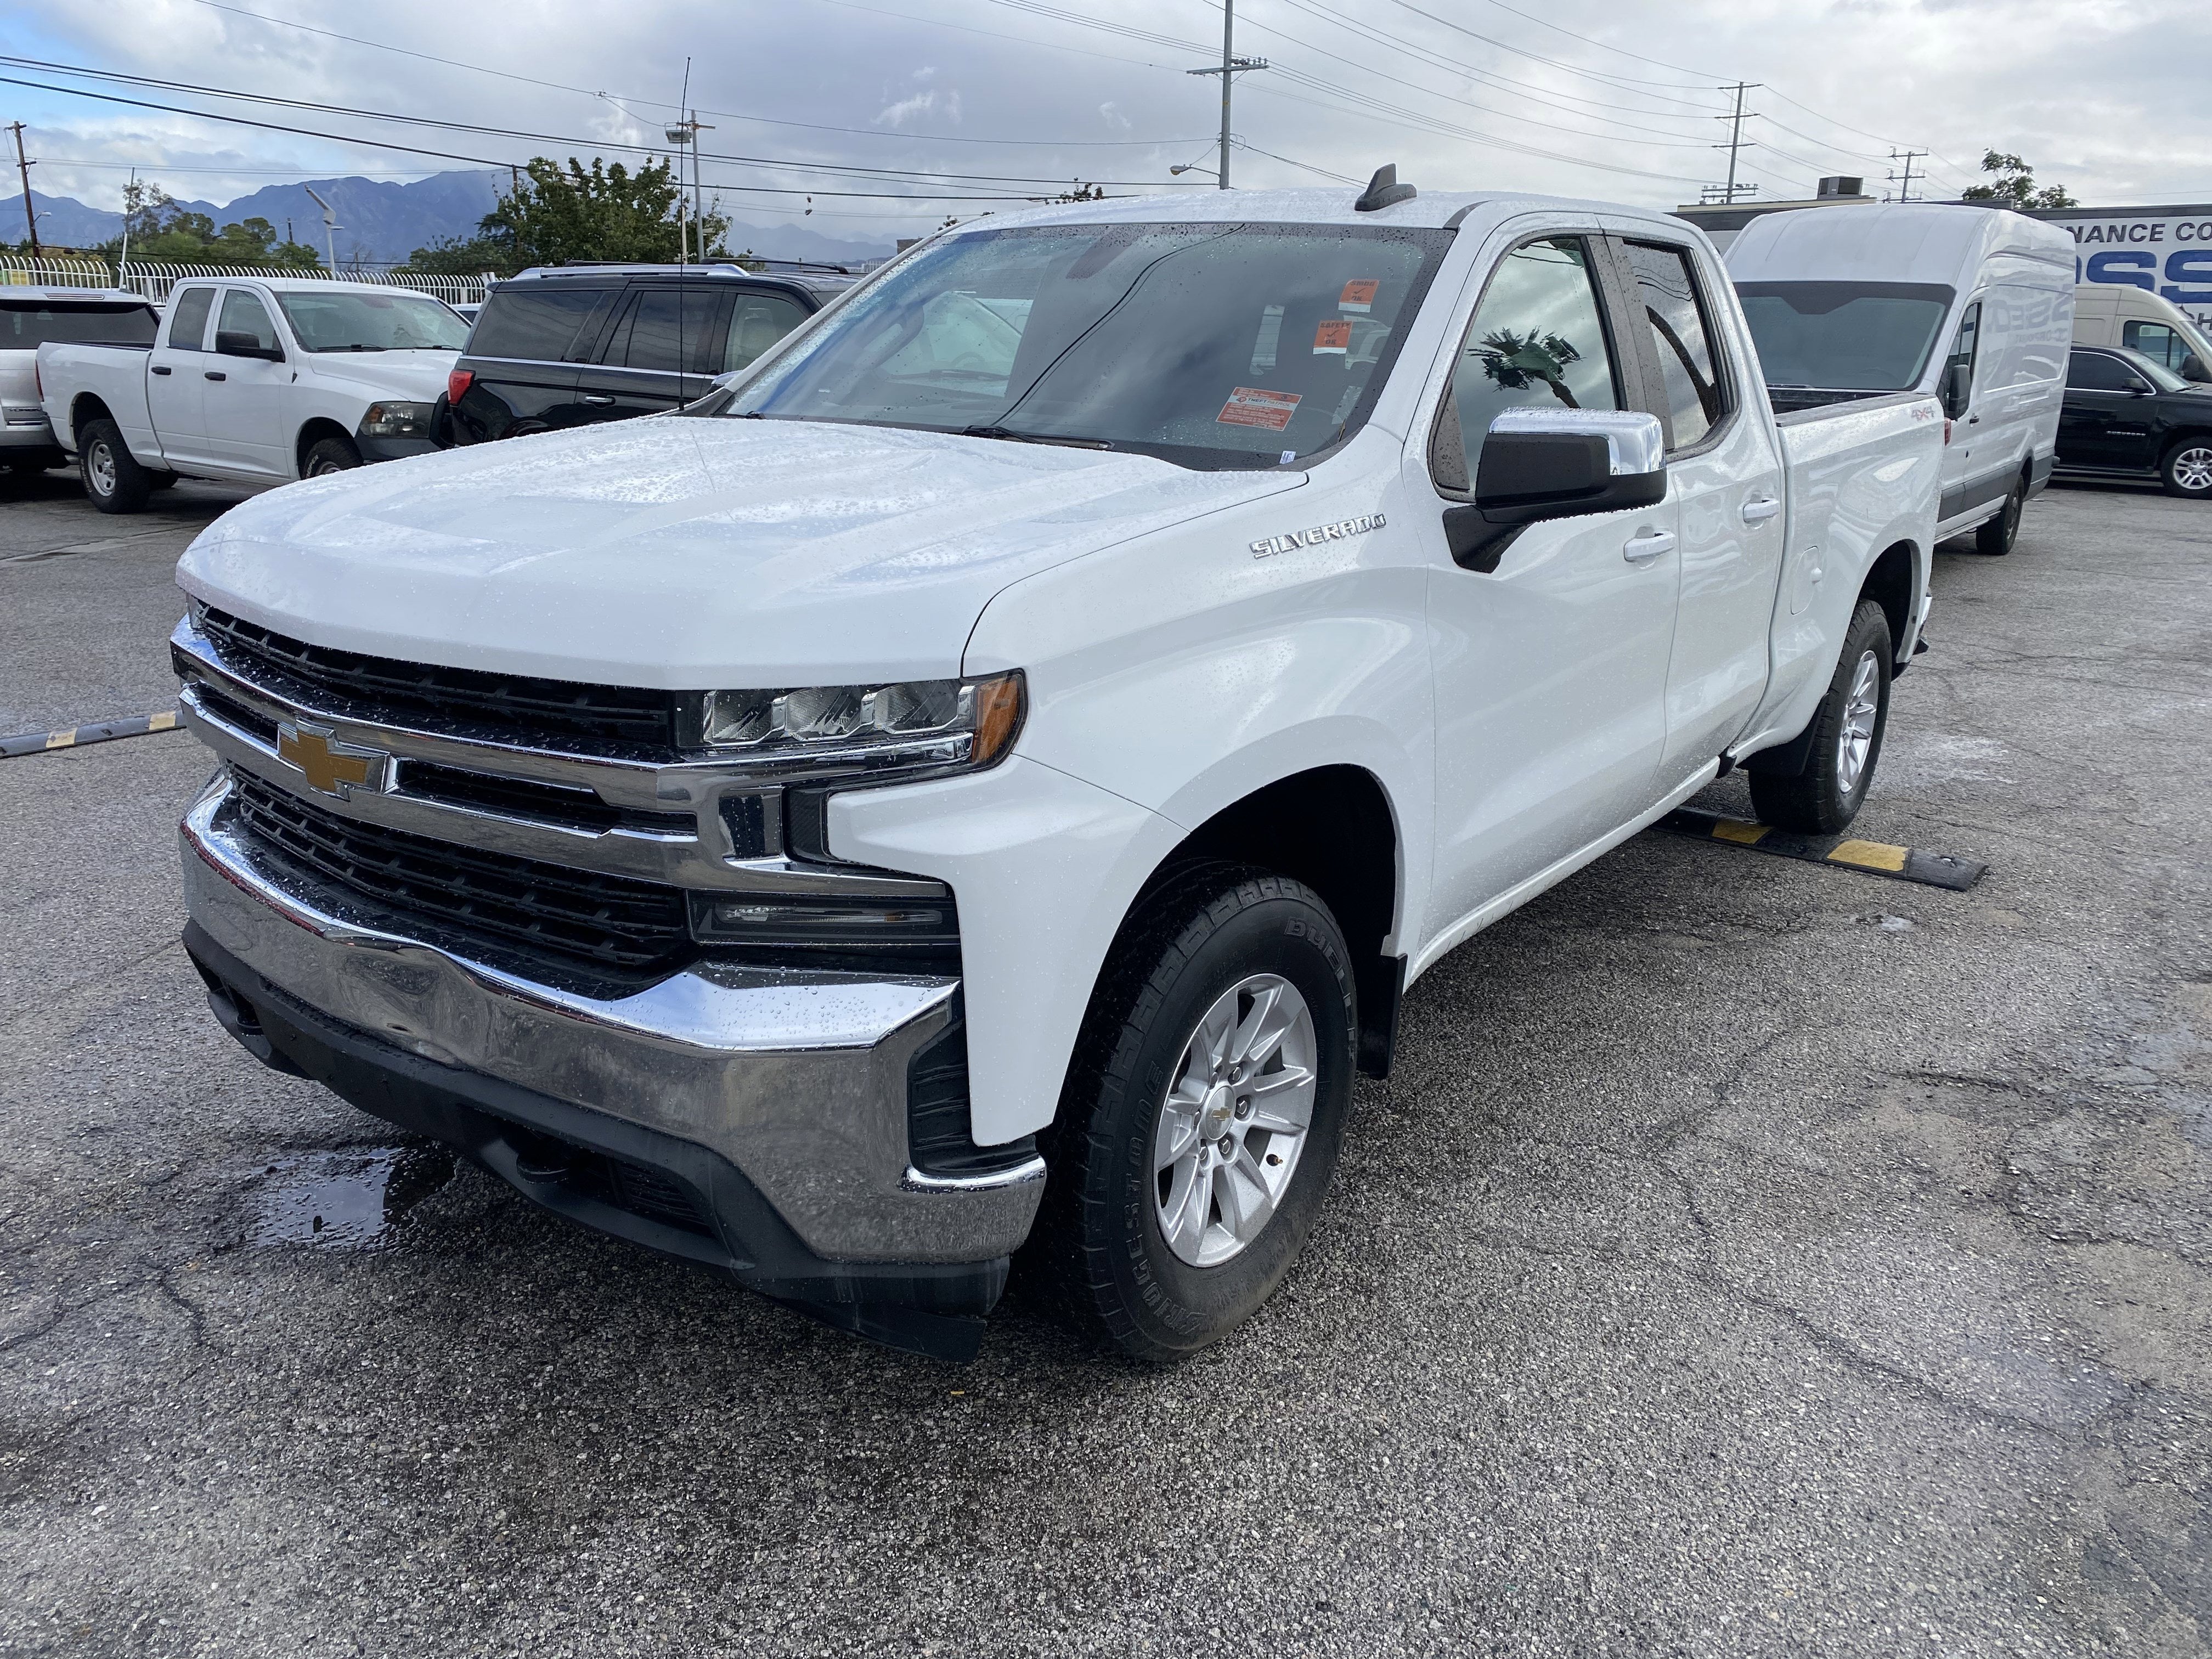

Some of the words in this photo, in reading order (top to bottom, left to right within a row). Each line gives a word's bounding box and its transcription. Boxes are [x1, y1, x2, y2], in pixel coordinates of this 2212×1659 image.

[2059, 223, 2166, 243] NANCE
[2075, 249, 2212, 303] SS
[1249, 513, 1386, 558] SILVERADO
